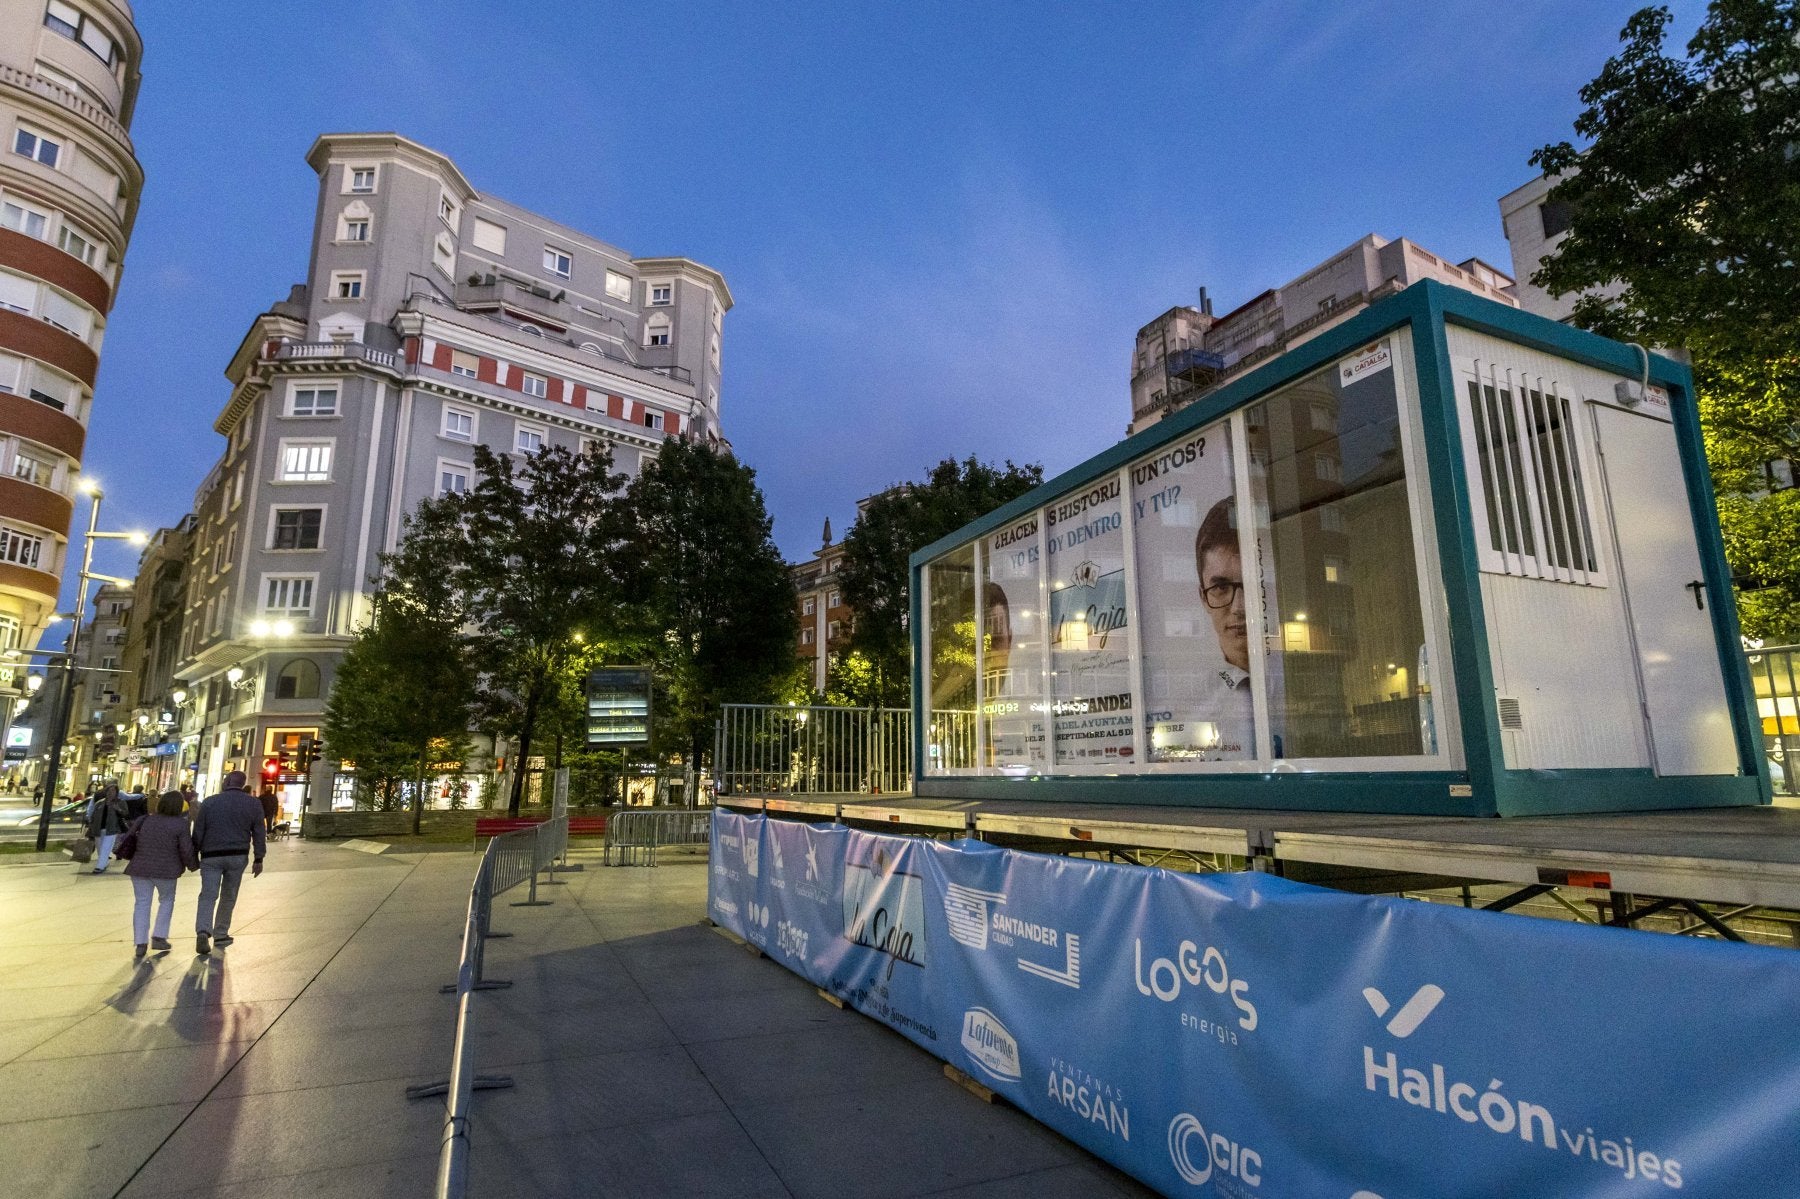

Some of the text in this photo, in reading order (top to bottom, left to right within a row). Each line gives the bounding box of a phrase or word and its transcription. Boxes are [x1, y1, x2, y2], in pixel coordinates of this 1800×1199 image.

[994, 509, 1057, 550] ¿HACEMS
[1028, 536, 1064, 564] ESOY
[1067, 511, 1122, 548] DENTRO
[1106, 729, 1118, 737] AL
[872, 907, 915, 982] Caja
[992, 912, 1058, 948] SANTANDER
[1135, 937, 1258, 1032] LOGOS
[968, 1015, 1014, 1062] Lafuente
[1051, 1056, 1122, 1102] VENTANAS
[1047, 1070, 1130, 1142] ARSAN
[1363, 1045, 1683, 1189] Halcón viajes
